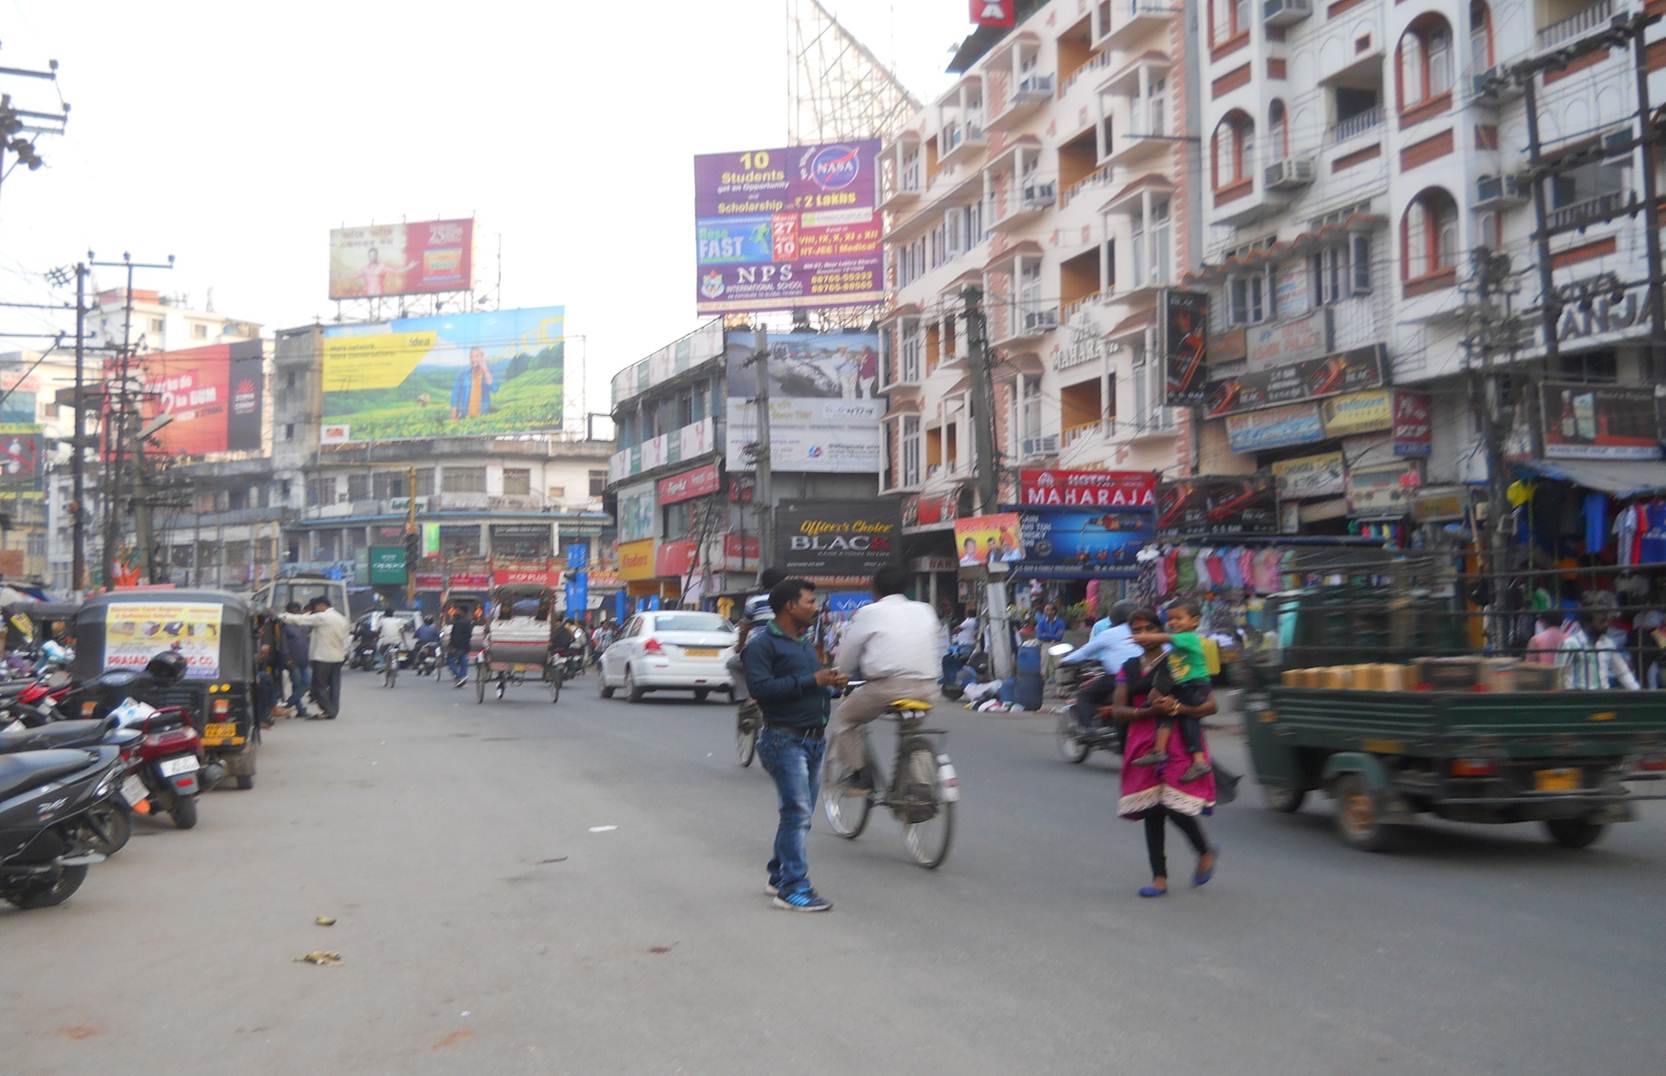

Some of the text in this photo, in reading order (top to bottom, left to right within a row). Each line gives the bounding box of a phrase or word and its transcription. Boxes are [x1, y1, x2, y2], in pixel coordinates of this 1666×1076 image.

[740, 151, 769, 169] 10
[817, 161, 854, 174] NASA
[721, 170, 784, 184] Students
[718, 200, 783, 214] Scholarship
[804, 195, 814, 208] 2
[816, 192, 856, 207] Lakhs
[774, 221, 795, 234] 27
[700, 236, 745, 260] FAST
[774, 241, 795, 255] 10
[1028, 487, 1156, 506] MAHARAJA
[800, 520, 894, 536] Officer's Choice
[790, 535, 892, 551] BLACK
